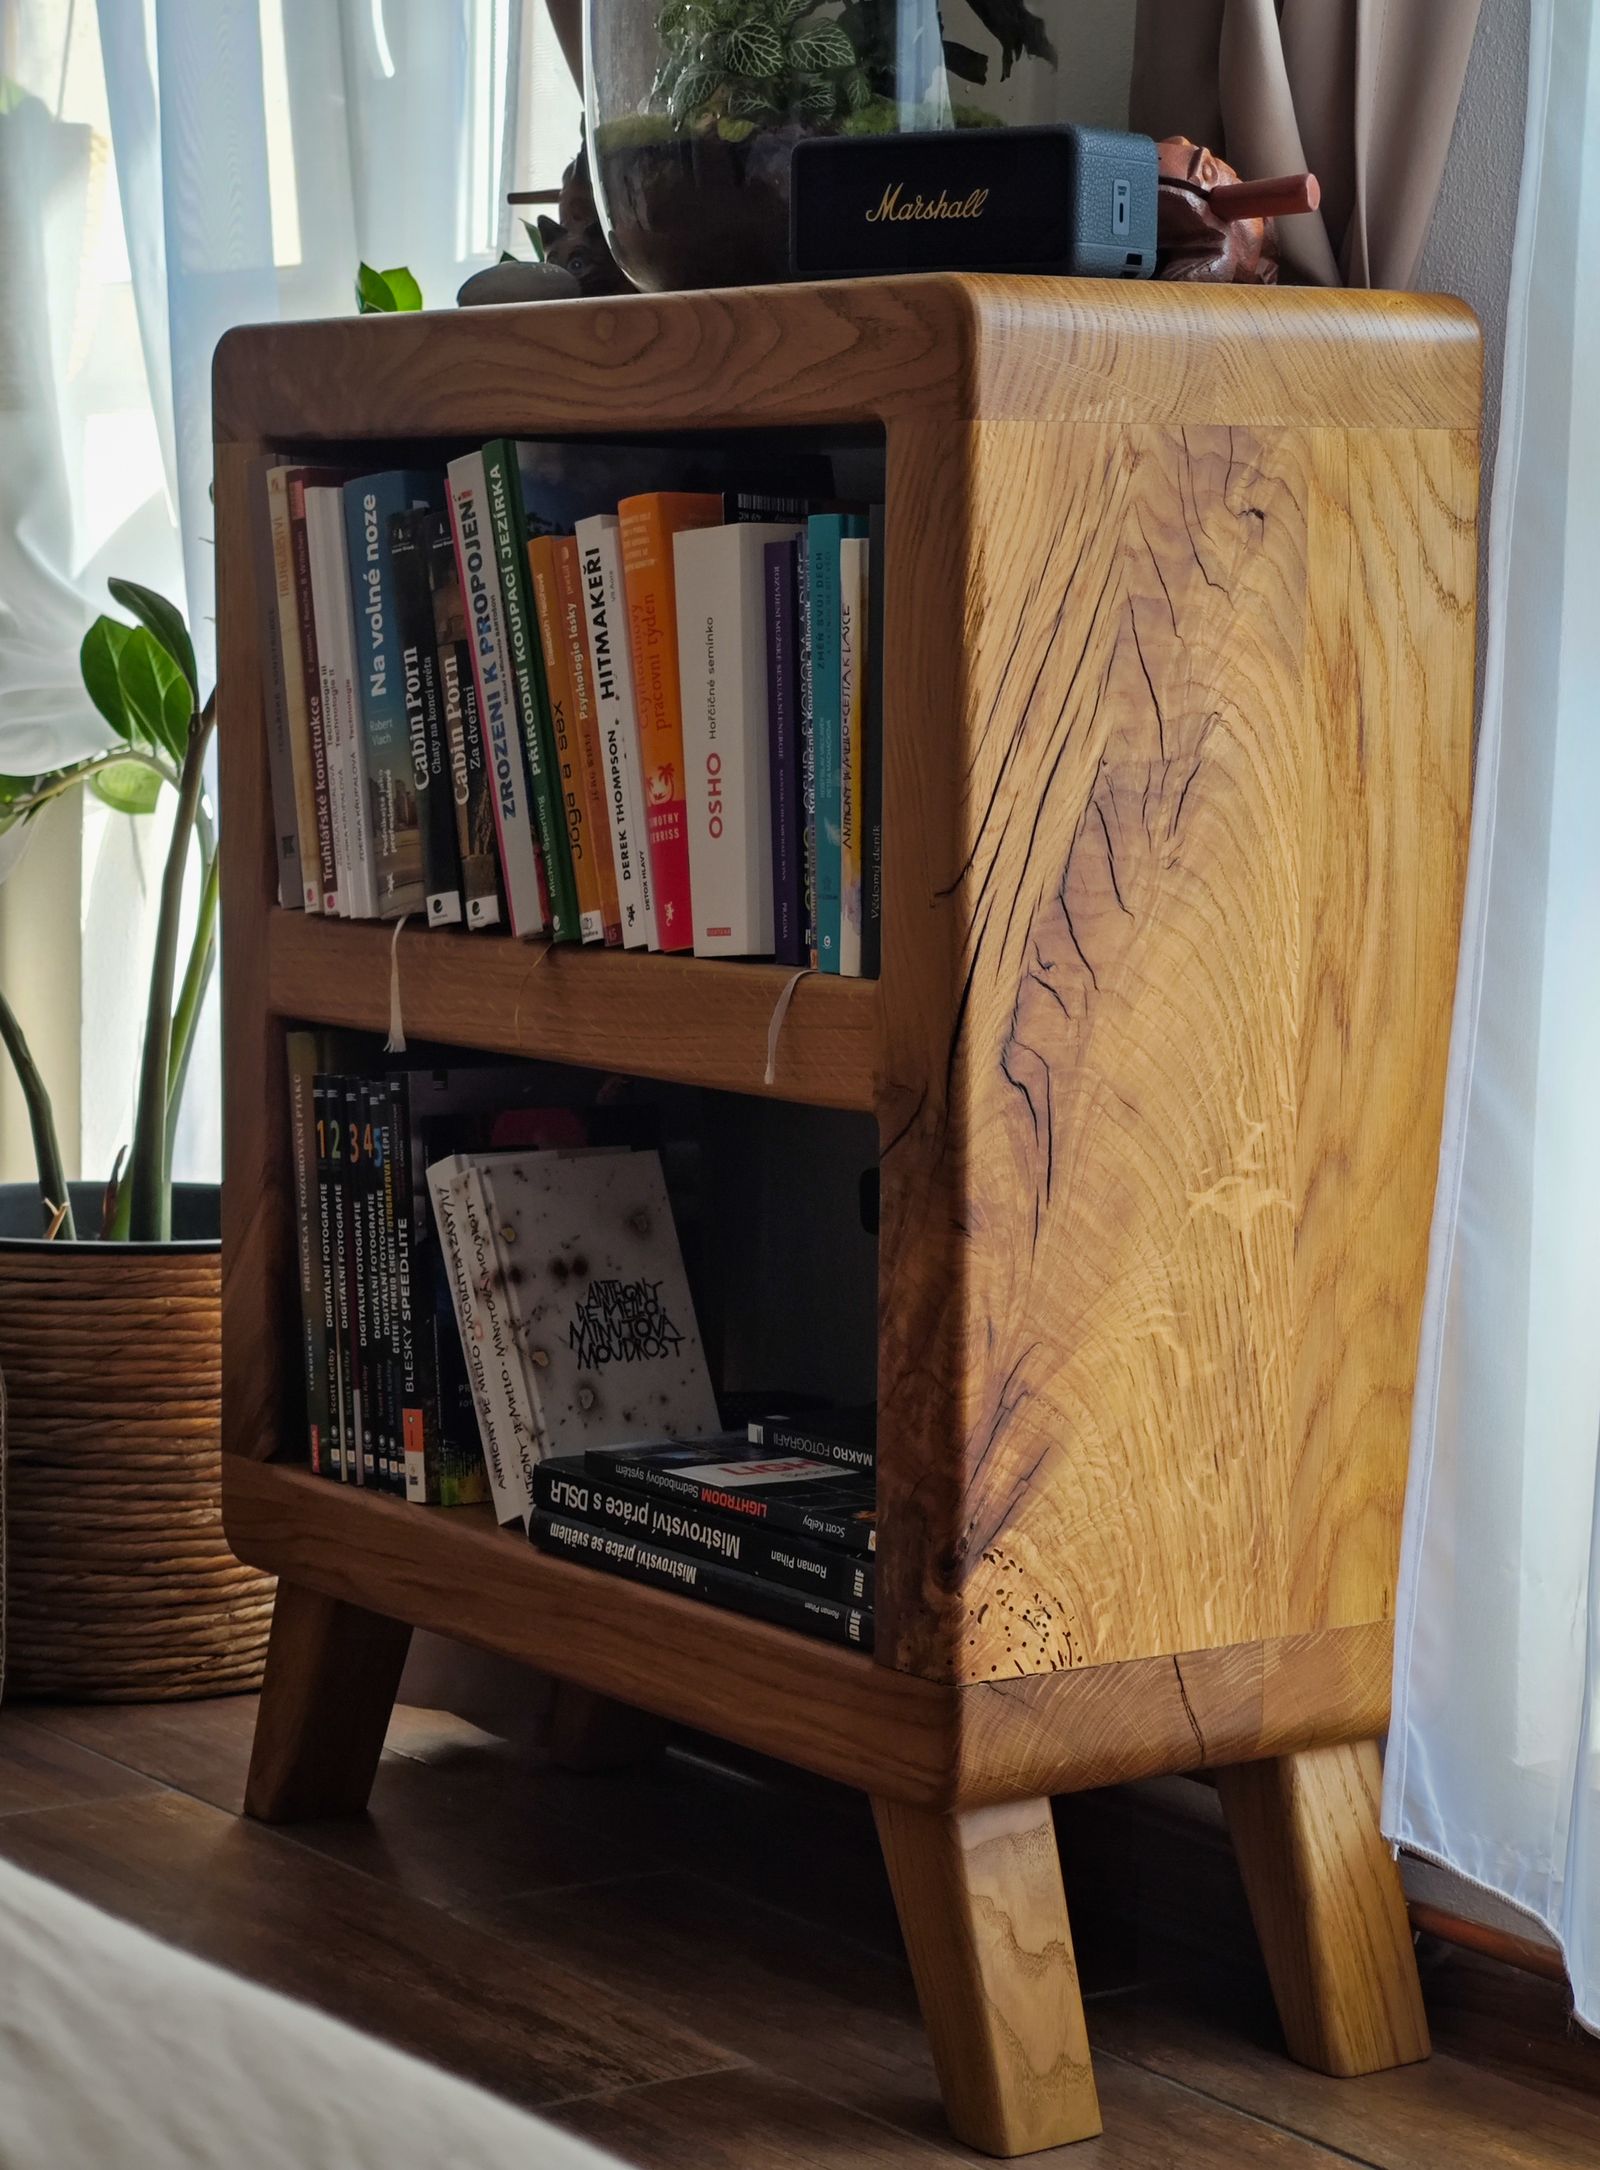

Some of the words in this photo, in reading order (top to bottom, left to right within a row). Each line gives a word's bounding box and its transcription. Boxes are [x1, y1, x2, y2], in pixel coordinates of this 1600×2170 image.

[865, 182, 989, 222] Marshall
[362, 493, 379, 562] noze
[489, 463, 512, 559] JEZÍRKA
[363, 567, 384, 650] volné
[501, 564, 526, 663] KOUPACÍ
[583, 548, 615, 700] HITMAKEŘI
[642, 593, 664, 646] týden
[705, 616, 715, 675] semínko
[369, 654, 387, 697] Na
[403, 645, 423, 712] Porn
[422, 656, 434, 689] světa
[444, 656, 462, 722] Porn
[482, 661, 498, 685] K
[570, 640, 589, 720] Psychologie
[650, 653, 672, 731] pracovní
[322, 677, 333, 746] Technologie
[330, 679, 341, 747] Technologie
[425, 689, 437, 721] konci
[428, 722, 438, 737] na
[462, 684, 479, 745] dveřmi
[516, 668, 541, 776] PŘÍRODNÍ
[552, 699, 568, 751] sex
[309, 696, 326, 791] konstrukce
[410, 714, 430, 791] Cabin
[431, 737, 442, 775] Chaty
[450, 726, 470, 806] Cabin
[469, 749, 481, 770] Za
[607, 730, 625, 825] THOMPSON
[706, 752, 723, 839] OSHO
[318, 794, 334, 882] Truhlářské
[536, 795, 550, 852] Šperling
[543, 854, 557, 898] Michal
[617, 829, 631, 881] DEREK
[638, 849, 648, 879] HLAVY
[642, 880, 650, 911] DETOX
[316, 1119, 326, 1159] 1
[330, 1119, 342, 1160] 2
[349, 1123, 360, 1164] 3
[363, 1123, 374, 1159] 4
[373, 1127, 383, 1168] 5
[319, 1183, 331, 1262] FOTOGRAFIE
[334, 1183, 345, 1262] FOTOGRAFIE
[353, 1201, 364, 1278] FOTOGRAFIE
[367, 1193, 378, 1273] FOTOGRAFIE
[376, 1189, 388, 1272] FOTOGRAFIE
[323, 1264, 334, 1328] DIGITÁLNÍ
[397, 1218, 412, 1322] SPEEDLITE
[337, 1264, 348, 1329] DIGITÁLNÍ
[356, 1279, 368, 1347] DIGITÁLNÍ
[368, 1274, 381, 1340] DIGITÁLNÍ
[379, 1274, 391, 1336] DIGITÁLNÍ
[328, 1347, 336, 1381] Kelby
[402, 1326, 415, 1393] BLESKY
[472, 1344, 488, 1395] MELLO
[577, 1336, 686, 1375] MOUDROST
[501, 1368, 520, 1418] MELLO
[487, 1418, 507, 1490] ANTHONY
[615, 1464, 645, 1480] systém
[832, 1445, 873, 1467] MAKRO
[550, 1479, 589, 1512] DSLR
[593, 1492, 603, 1511] s
[645, 1470, 699, 1499] Sedmibodový
[700, 1487, 768, 1519] LIGHTROOM
[550, 1521, 590, 1549] světlem
[605, 1496, 649, 1526] práce
[651, 1510, 741, 1560] Mistrovství
[802, 1514, 824, 1533] Kelby
[825, 1524, 846, 1539] Scott
[590, 1535, 605, 1552] se
[605, 1541, 637, 1562] práce
[635, 1550, 697, 1585] Mistrovství
[770, 1549, 795, 1569] Pihan
[796, 1558, 828, 1580] Roman
